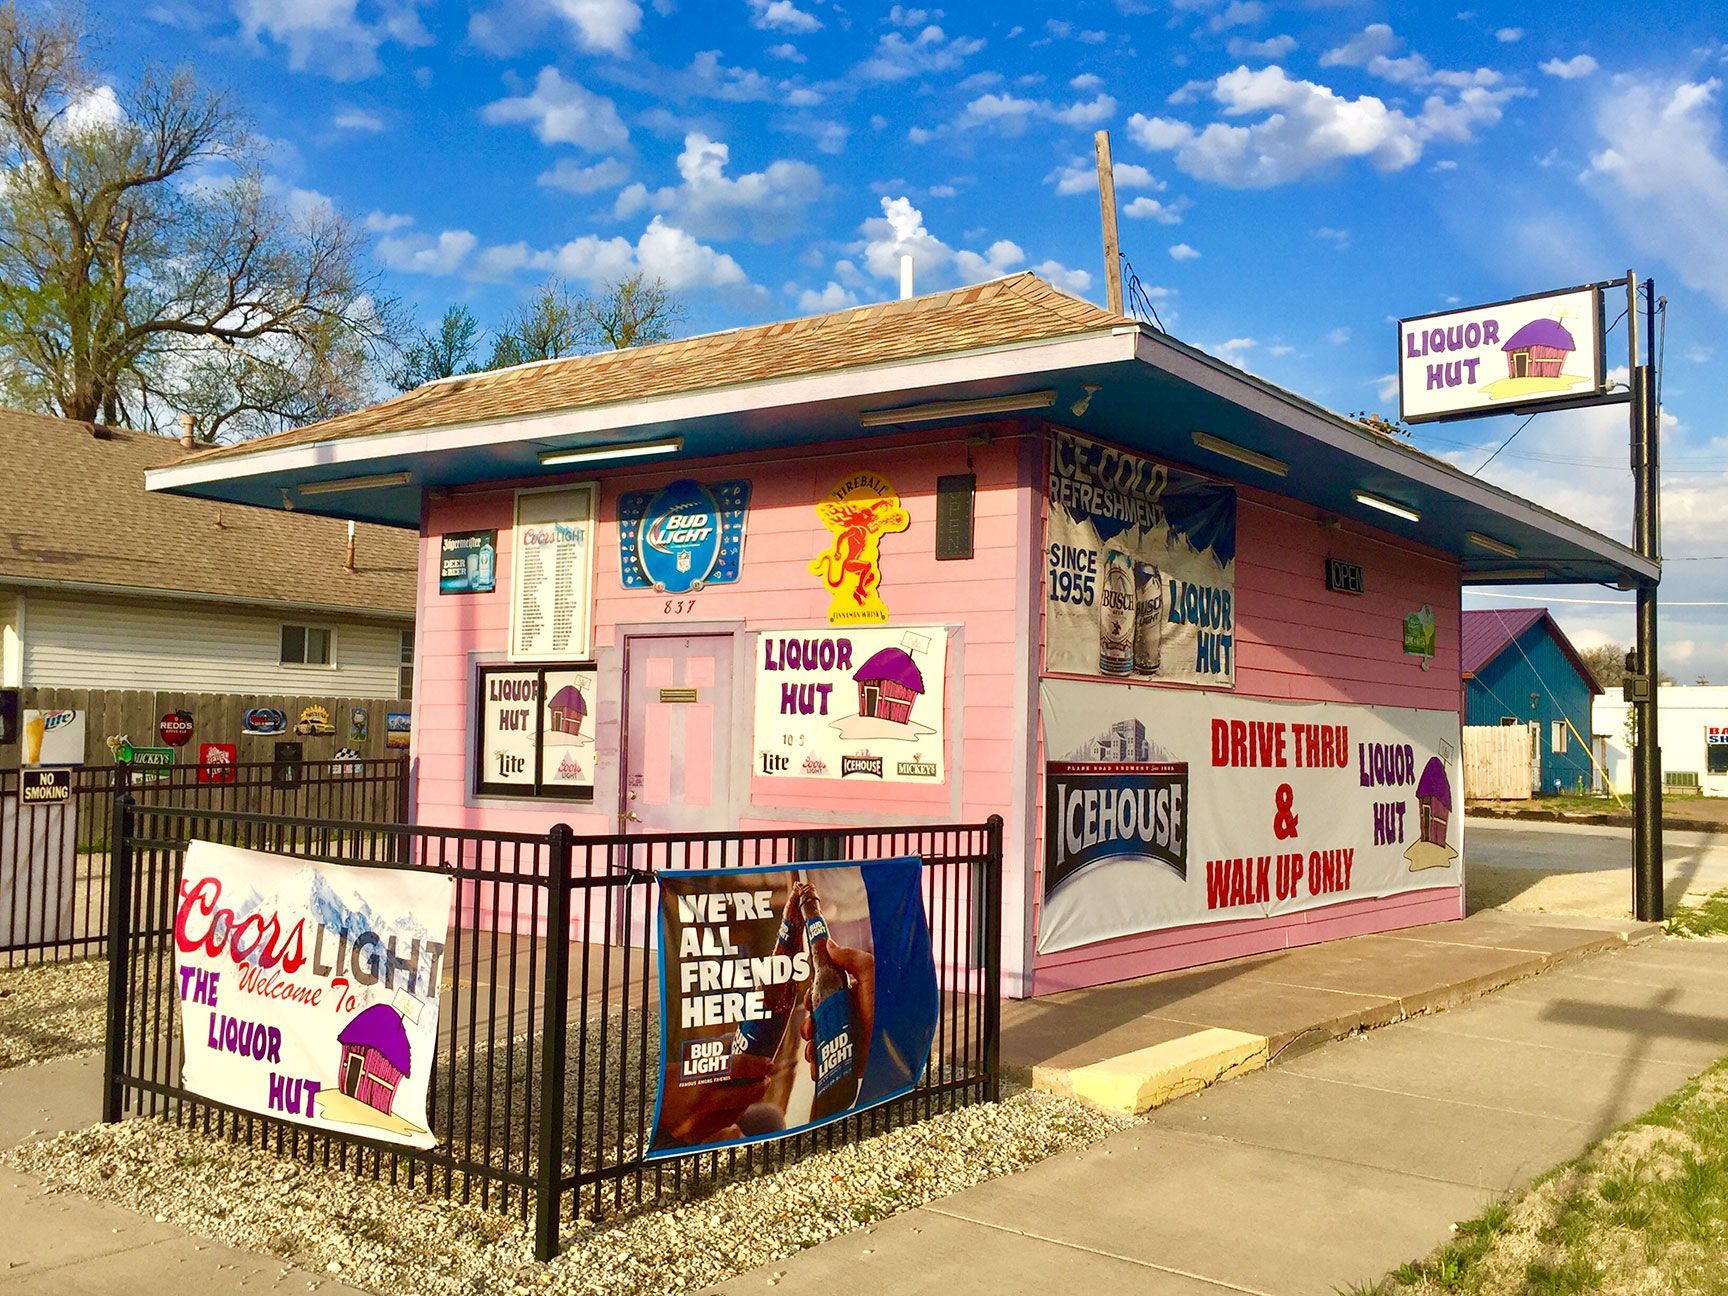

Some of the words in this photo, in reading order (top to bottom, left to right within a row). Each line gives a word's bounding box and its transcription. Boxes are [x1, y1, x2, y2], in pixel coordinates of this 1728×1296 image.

[1407, 319, 1500, 358] LIQUOR
[1426, 358, 1480, 390] HUT
[1050, 431, 1168, 502] ICE-COLD
[1049, 474, 1164, 527] REFRESHMENT
[523, 528, 555, 545] Coors
[556, 529, 584, 542] LIGHT
[656, 528, 713, 545] LIGHT
[666, 514, 708, 530] BUD
[444, 559, 465, 568] DEER
[1050, 543, 1097, 574] SINCE
[1049, 569, 1095, 606] 1955
[1333, 563, 1363, 591] OPEN
[663, 600, 696, 614] 837
[1102, 590, 1134, 610] BUSCH
[1168, 580, 1232, 631] LIQUOR
[764, 638, 853, 671] LIQUOR
[1196, 630, 1232, 676] HUT
[490, 679, 548, 701] LIQUOR
[780, 682, 833, 715] HUT
[45, 713, 71, 728] Lite
[499, 709, 529, 731] HUT
[1211, 718, 1287, 768] DRIVE
[1292, 721, 1349, 769] THRU
[40, 772, 54, 785] NO
[498, 753, 525, 777] Lite
[558, 759, 581, 773] Coors
[762, 753, 789, 775] Lite
[802, 756, 827, 769] Coors
[843, 758, 881, 774] ICEHOUSE
[1358, 742, 1416, 787] LIQUOR
[25, 786, 68, 799] SMOKING
[1056, 783, 1184, 867] ICEHOUSE
[1273, 783, 1299, 841] &
[1373, 801, 1406, 846] HUT
[1206, 854, 1270, 910] WALK
[1275, 852, 1304, 899] UP
[1307, 848, 1354, 896] ONLY
[677, 890, 774, 923] WE'RE
[175, 877, 306, 974] Coors
[312, 923, 447, 998] LIGHT
[680, 926, 739, 958] ALL
[180, 965, 220, 1007] THE
[238, 962, 322, 1007] Welcome
[331, 977, 356, 1012] To
[680, 952, 811, 993] FRIENDS
[681, 991, 772, 1029] HERE.
[207, 1012, 282, 1064] LIQUOR
[691, 1041, 723, 1059] BUD
[821, 1032, 849, 1062] BUD
[684, 1055, 730, 1076] LIGHT
[818, 1043, 854, 1079] LIGHT
[268, 1072, 321, 1118] HUT
